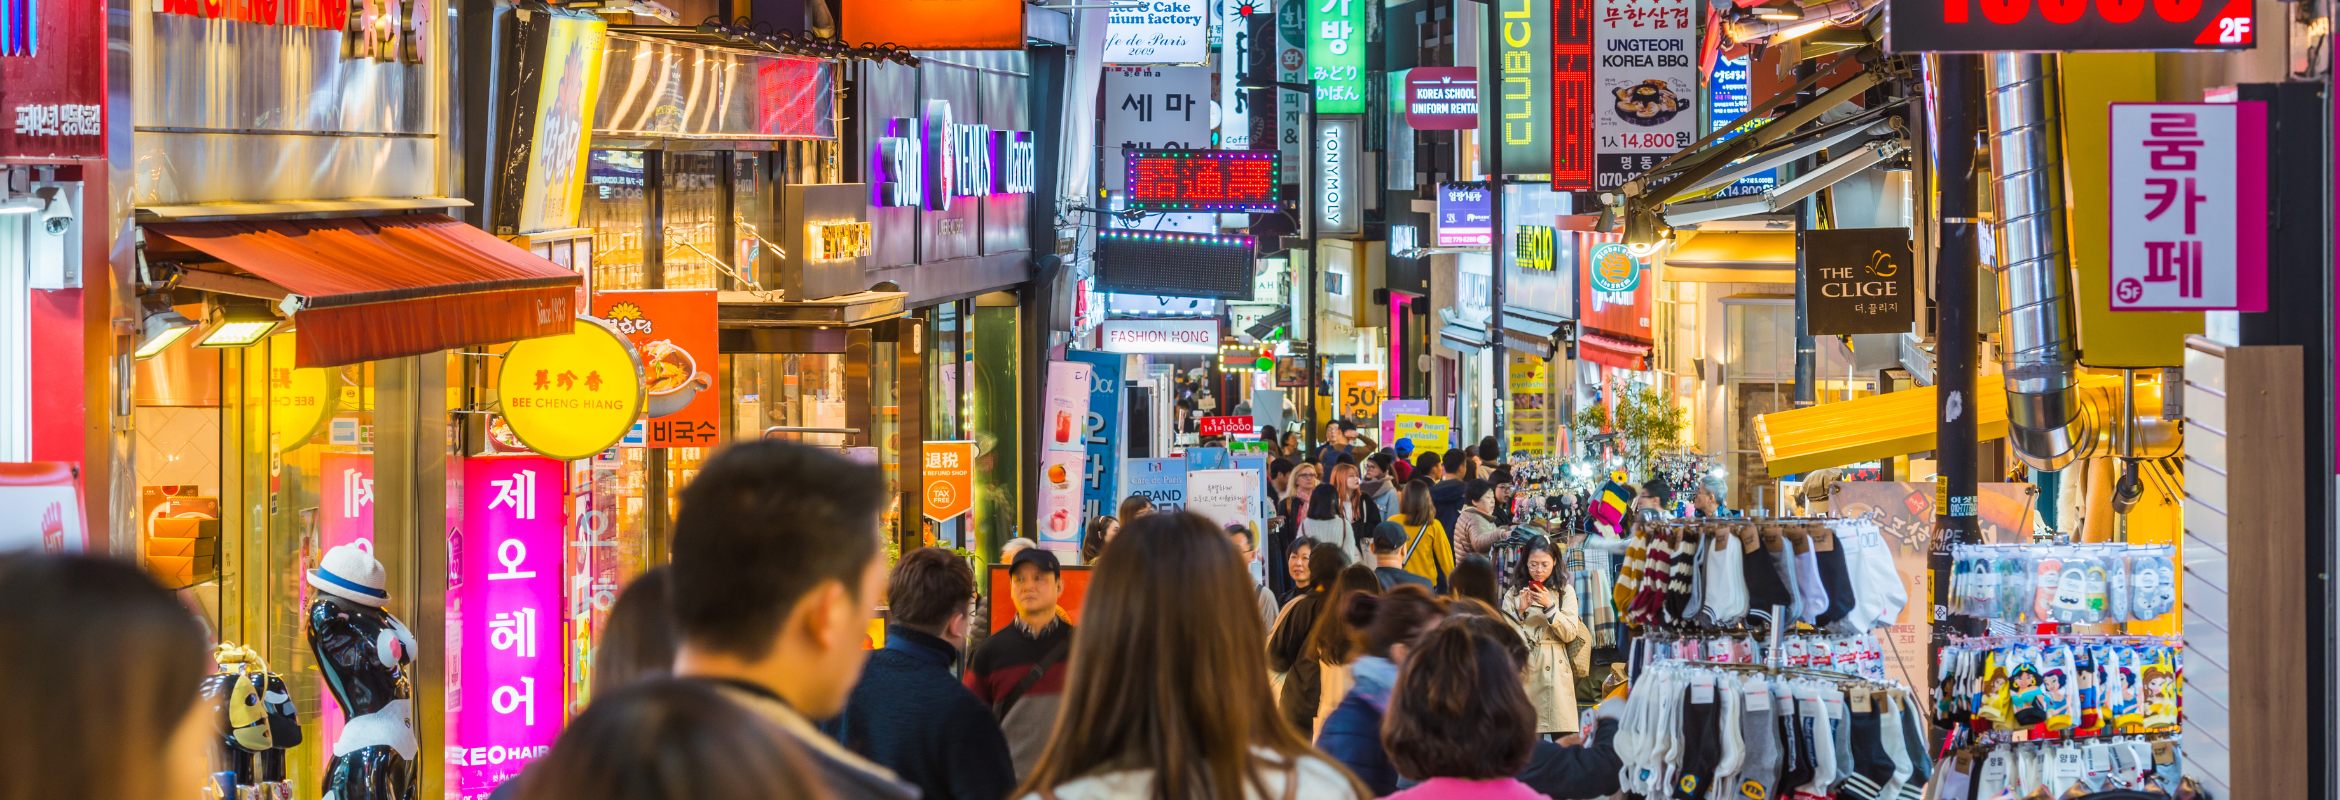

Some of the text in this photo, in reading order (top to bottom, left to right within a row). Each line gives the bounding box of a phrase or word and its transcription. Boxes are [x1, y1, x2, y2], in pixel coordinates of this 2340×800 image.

[1153, 2, 1191, 13] Cake
[1148, 13, 1202, 26] factory
[1603, 4, 1688, 30] 무한삼겹
[2219, 17, 2251, 43] 2F
[1126, 33, 1144, 46] de
[1148, 33, 1190, 46] Paris
[1607, 39, 1684, 52] UNGTEORI
[1128, 48, 1155, 56] 2009
[1602, 55, 1688, 68] KOREA BBQ
[1313, 66, 1357, 81] みどり
[1316, 85, 1360, 101] かばん
[1417, 88, 1476, 99] KOREA SCHOOL
[1505, 51, 1531, 145] CLUB
[1412, 103, 1449, 114] UNIFORM
[953, 124, 991, 197] VENUS
[1325, 127, 1341, 225] TONYMOLY
[2142, 112, 2207, 299] 룸카페
[1819, 267, 1854, 279] THE
[1821, 281, 1898, 298] CLIGE
[2119, 281, 2140, 300] 5F
[536, 298, 551, 327] Since
[1111, 330, 1209, 343] FASHION HONG
[533, 368, 604, 392] 美珍香
[512, 398, 624, 410] BEE CHENG HIANG
[1346, 387, 1377, 407] 50
[646, 420, 716, 443] 비국수
[1203, 423, 1251, 432] 1+1=10000
[1398, 421, 1446, 431] nail heart
[925, 452, 959, 468] 退税
[1163, 475, 1182, 485] Paris
[933, 490, 950, 498] TAX
[487, 469, 536, 726] 제오헤어
